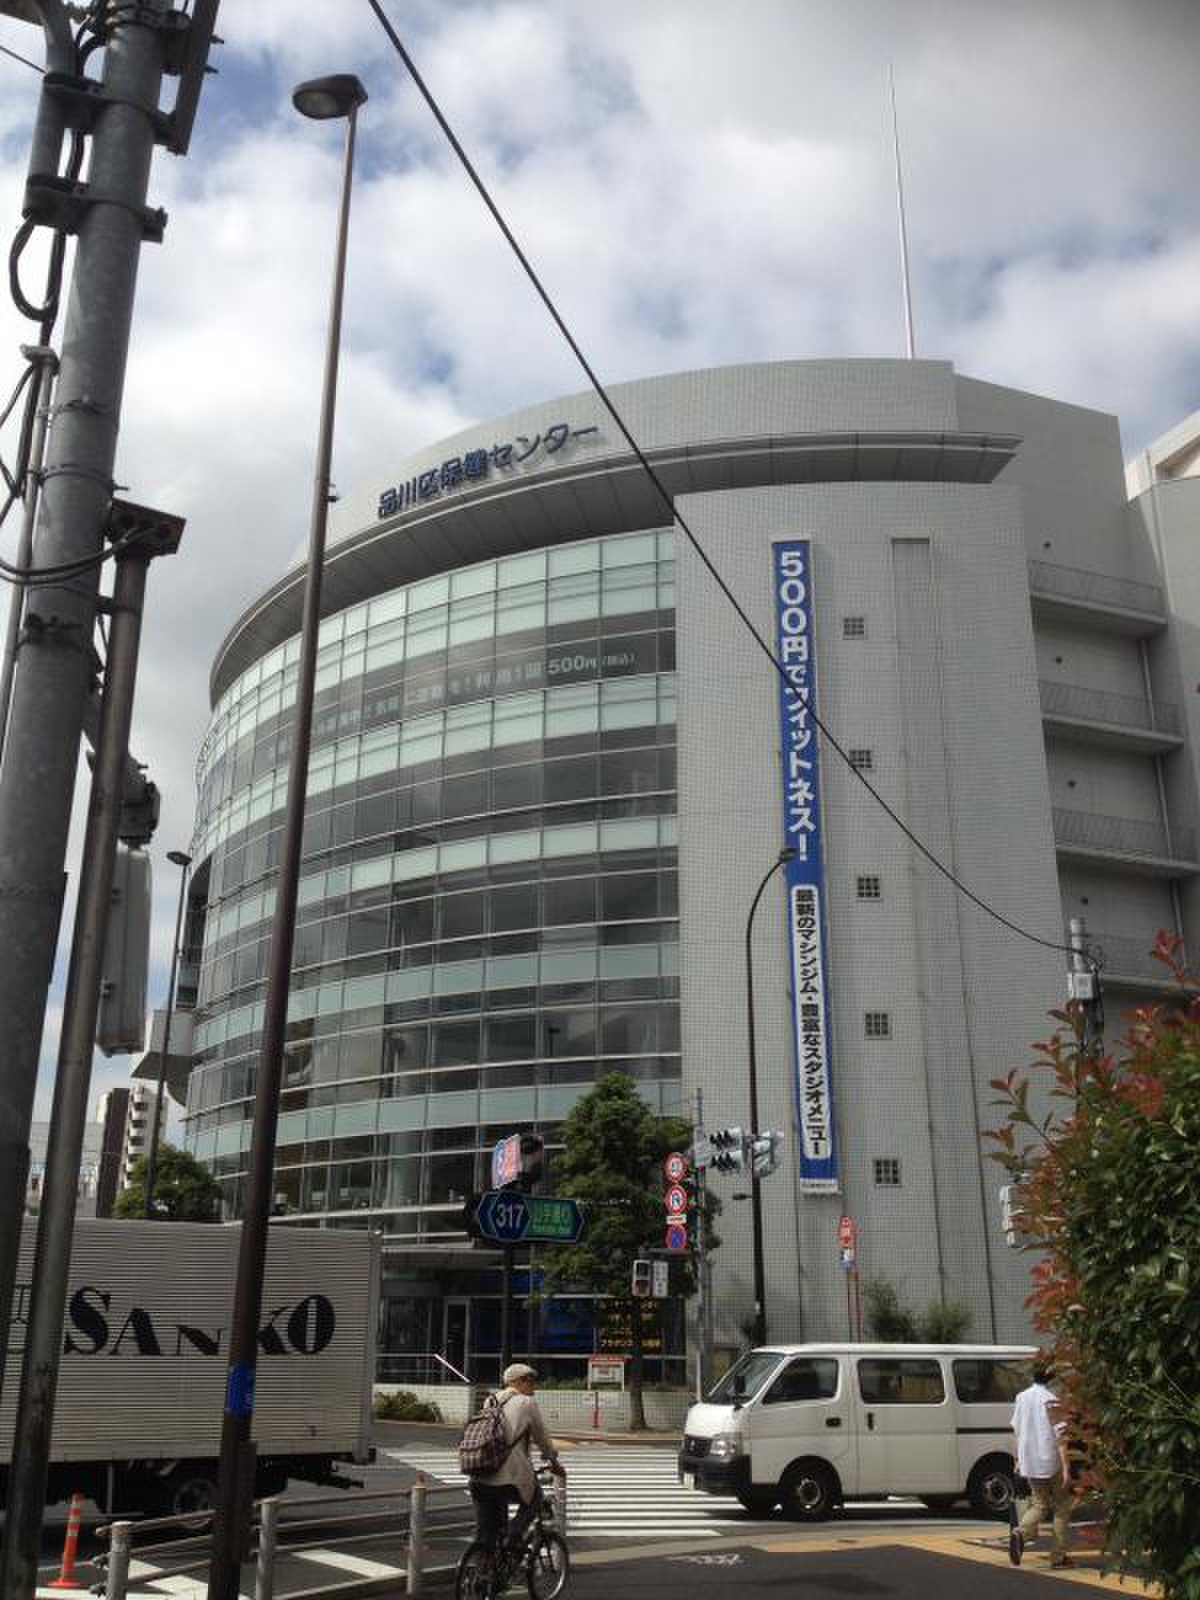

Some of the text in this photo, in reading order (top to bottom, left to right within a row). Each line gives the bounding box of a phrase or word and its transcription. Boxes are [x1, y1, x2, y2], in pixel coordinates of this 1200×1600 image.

[378, 423, 598, 519] 品川区保健センター
[495, 1203, 524, 1229] 317
